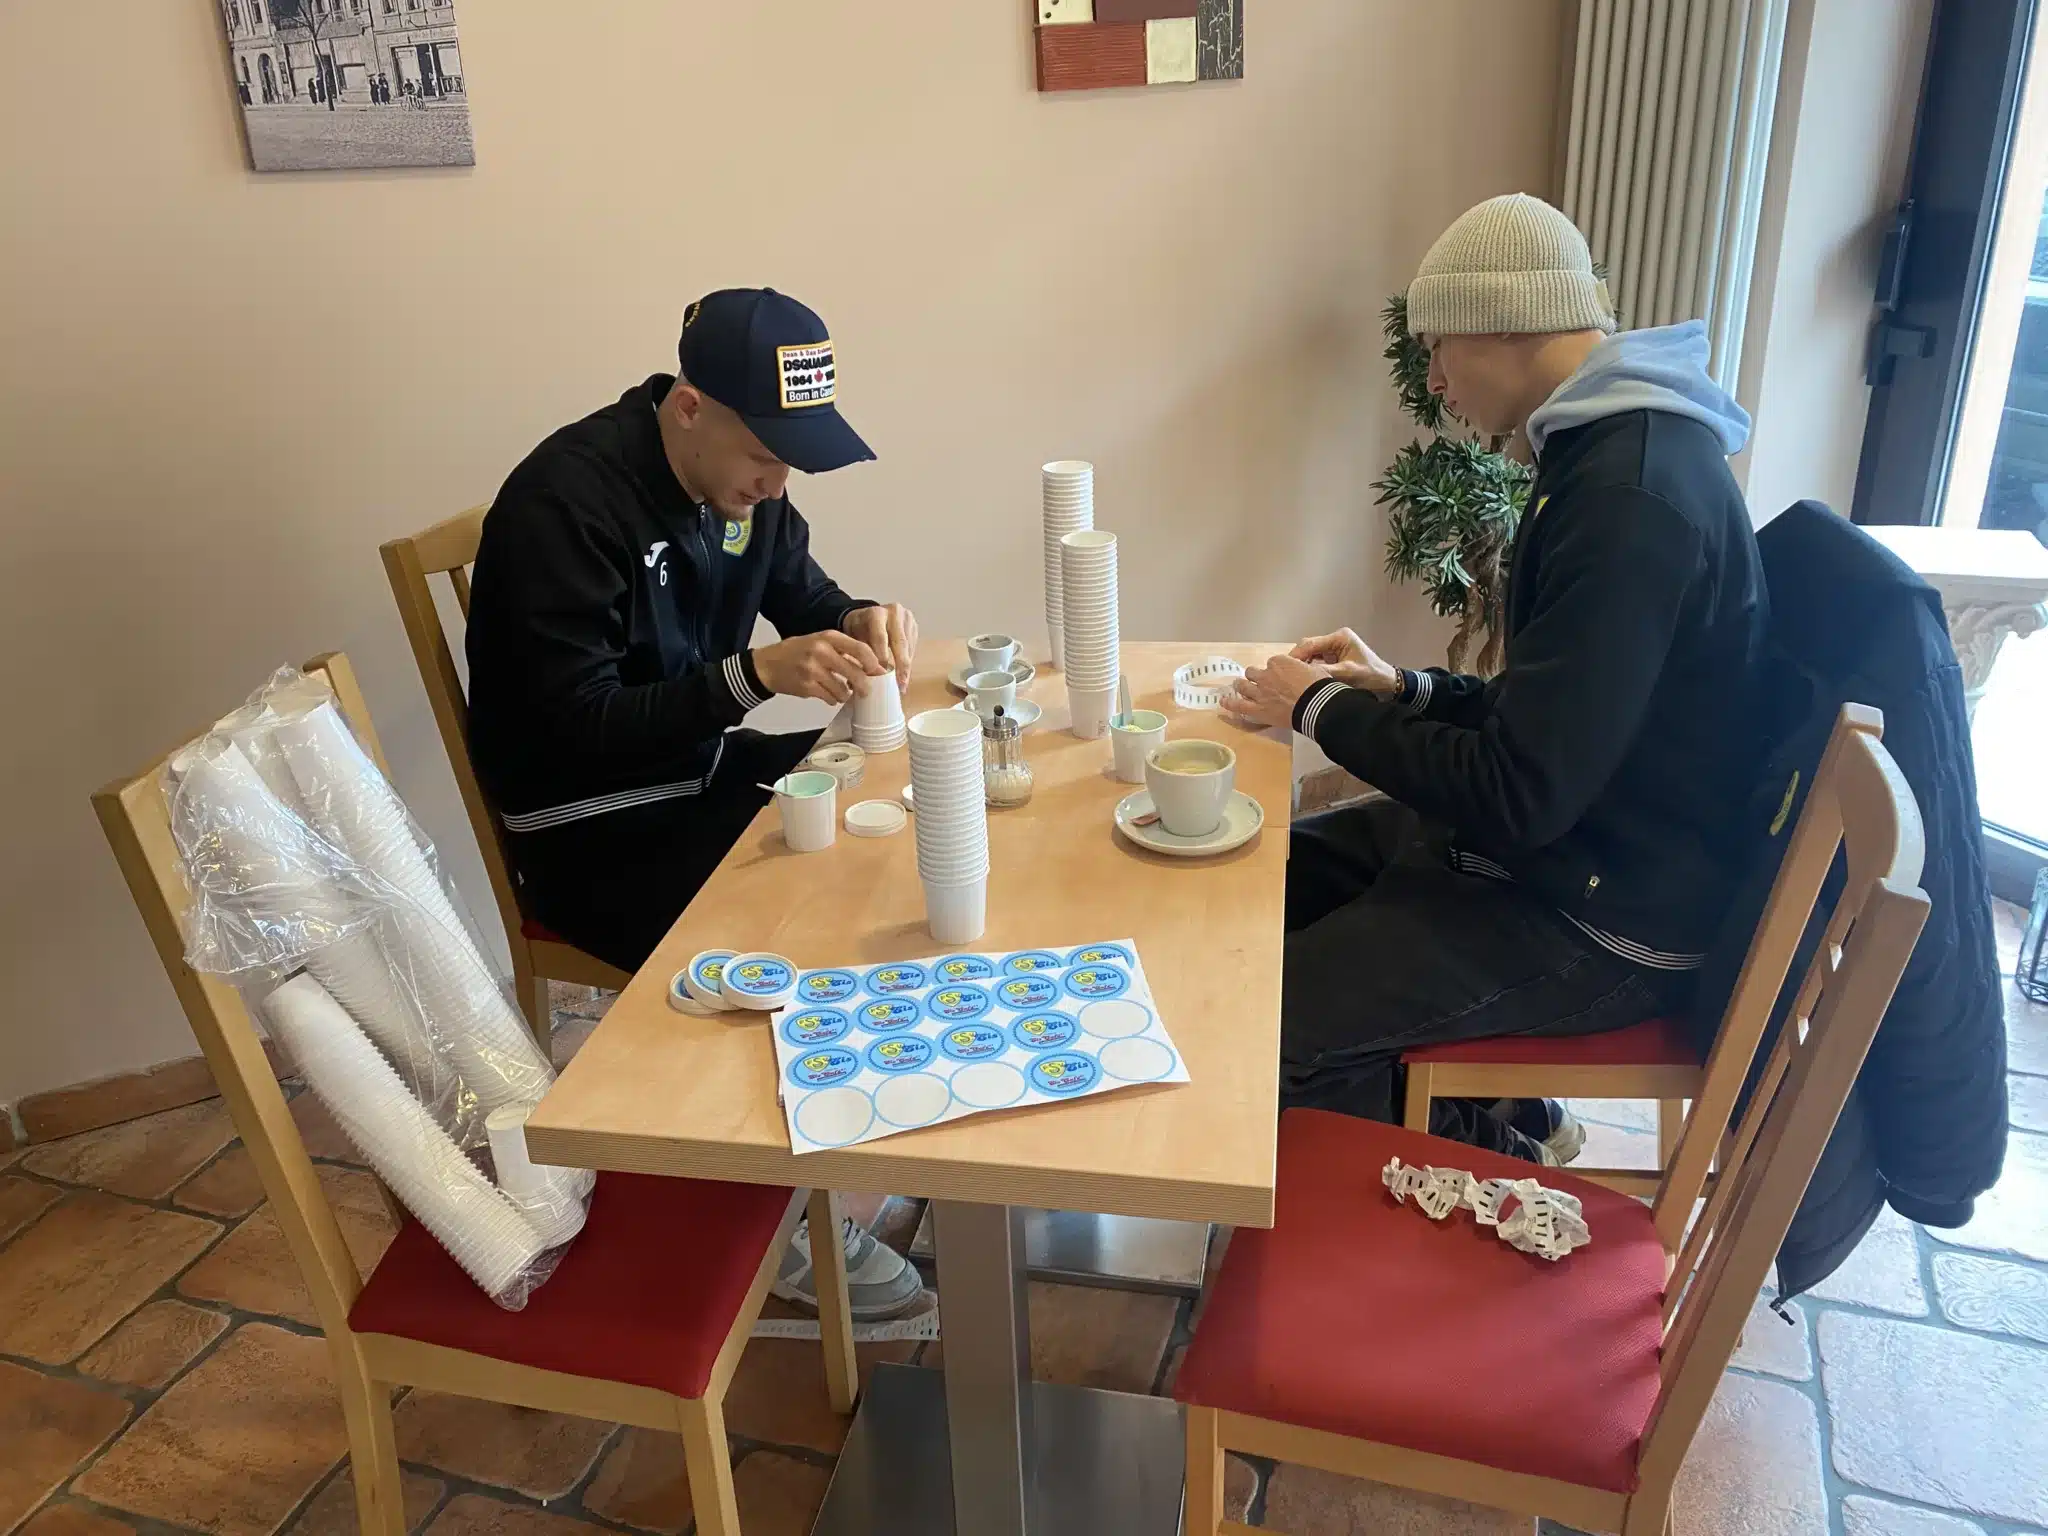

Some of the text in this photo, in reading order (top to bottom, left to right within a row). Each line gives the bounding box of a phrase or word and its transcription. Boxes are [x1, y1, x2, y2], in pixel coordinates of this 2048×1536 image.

[785, 374, 812, 387] 1964
[789, 391, 809, 401] Born
[811, 388, 819, 399] in
[660, 561, 667, 586] 6
